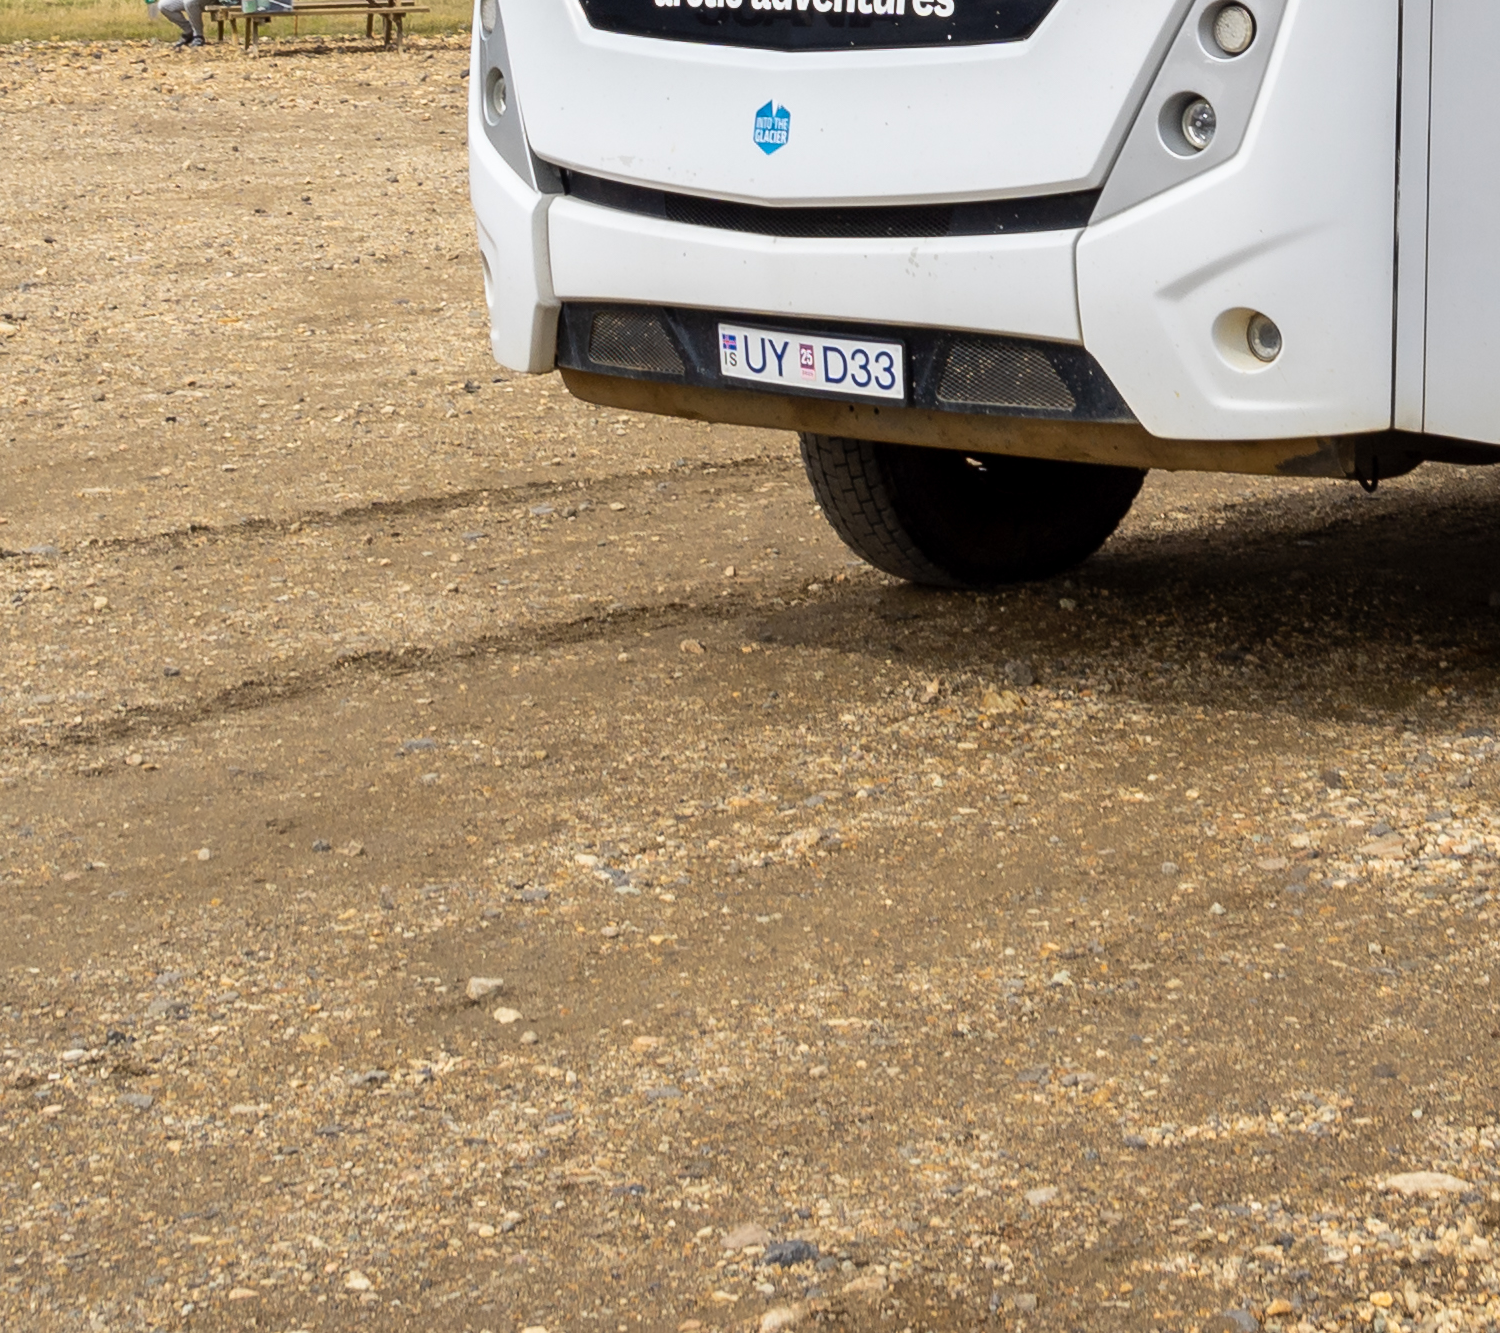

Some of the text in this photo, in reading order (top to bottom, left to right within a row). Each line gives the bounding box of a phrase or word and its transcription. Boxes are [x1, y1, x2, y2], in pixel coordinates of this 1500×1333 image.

[756, 117, 789, 130] INTO THE
[755, 129, 787, 144] GLACIER
[725, 335, 896, 391] IS UY 25 D33
